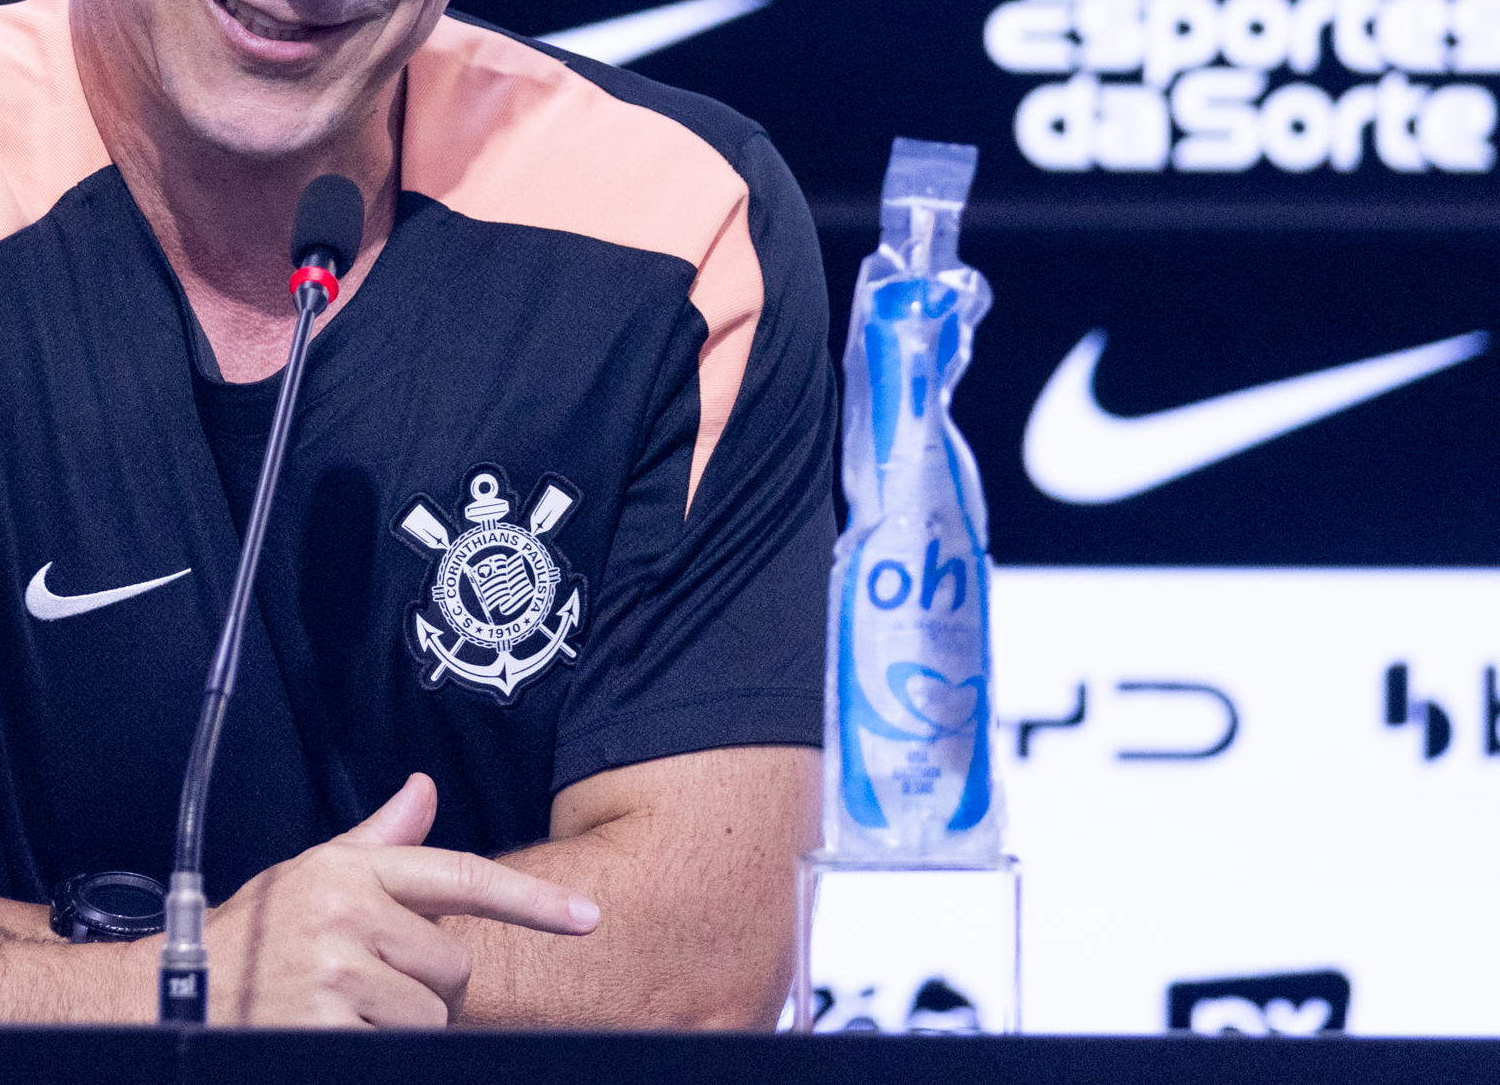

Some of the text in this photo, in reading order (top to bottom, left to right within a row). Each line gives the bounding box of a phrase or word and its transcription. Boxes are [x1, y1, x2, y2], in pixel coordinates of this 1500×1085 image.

[446, 532, 520, 599] CORINTHIANS
[521, 542, 548, 613] PAULISTA
[867, 537, 967, 611] oh
[487, 623, 521, 639] 1910
